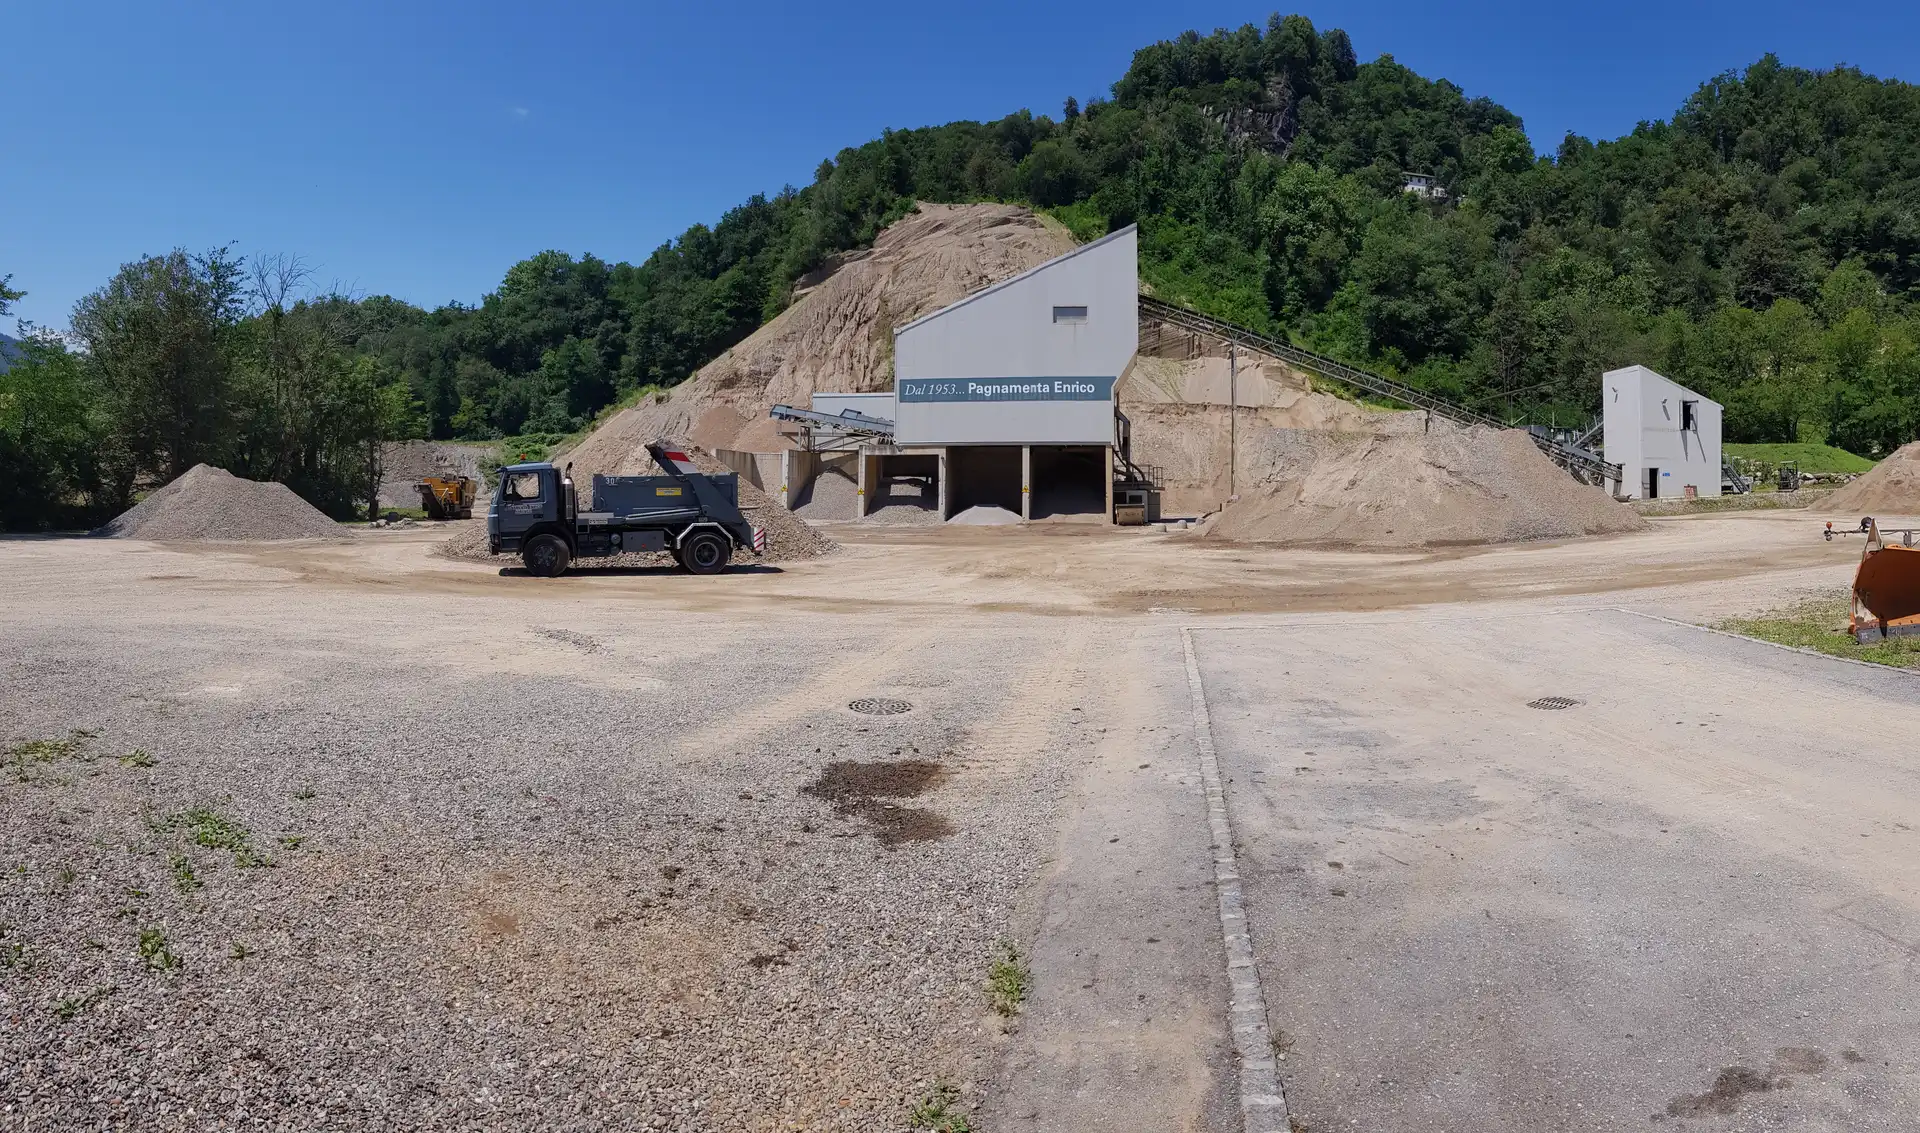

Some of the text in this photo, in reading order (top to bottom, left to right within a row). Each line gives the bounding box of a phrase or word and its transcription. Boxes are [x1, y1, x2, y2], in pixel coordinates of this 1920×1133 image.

[904, 381, 1095, 397] Dal 1953... Pagnamenta Enrico
